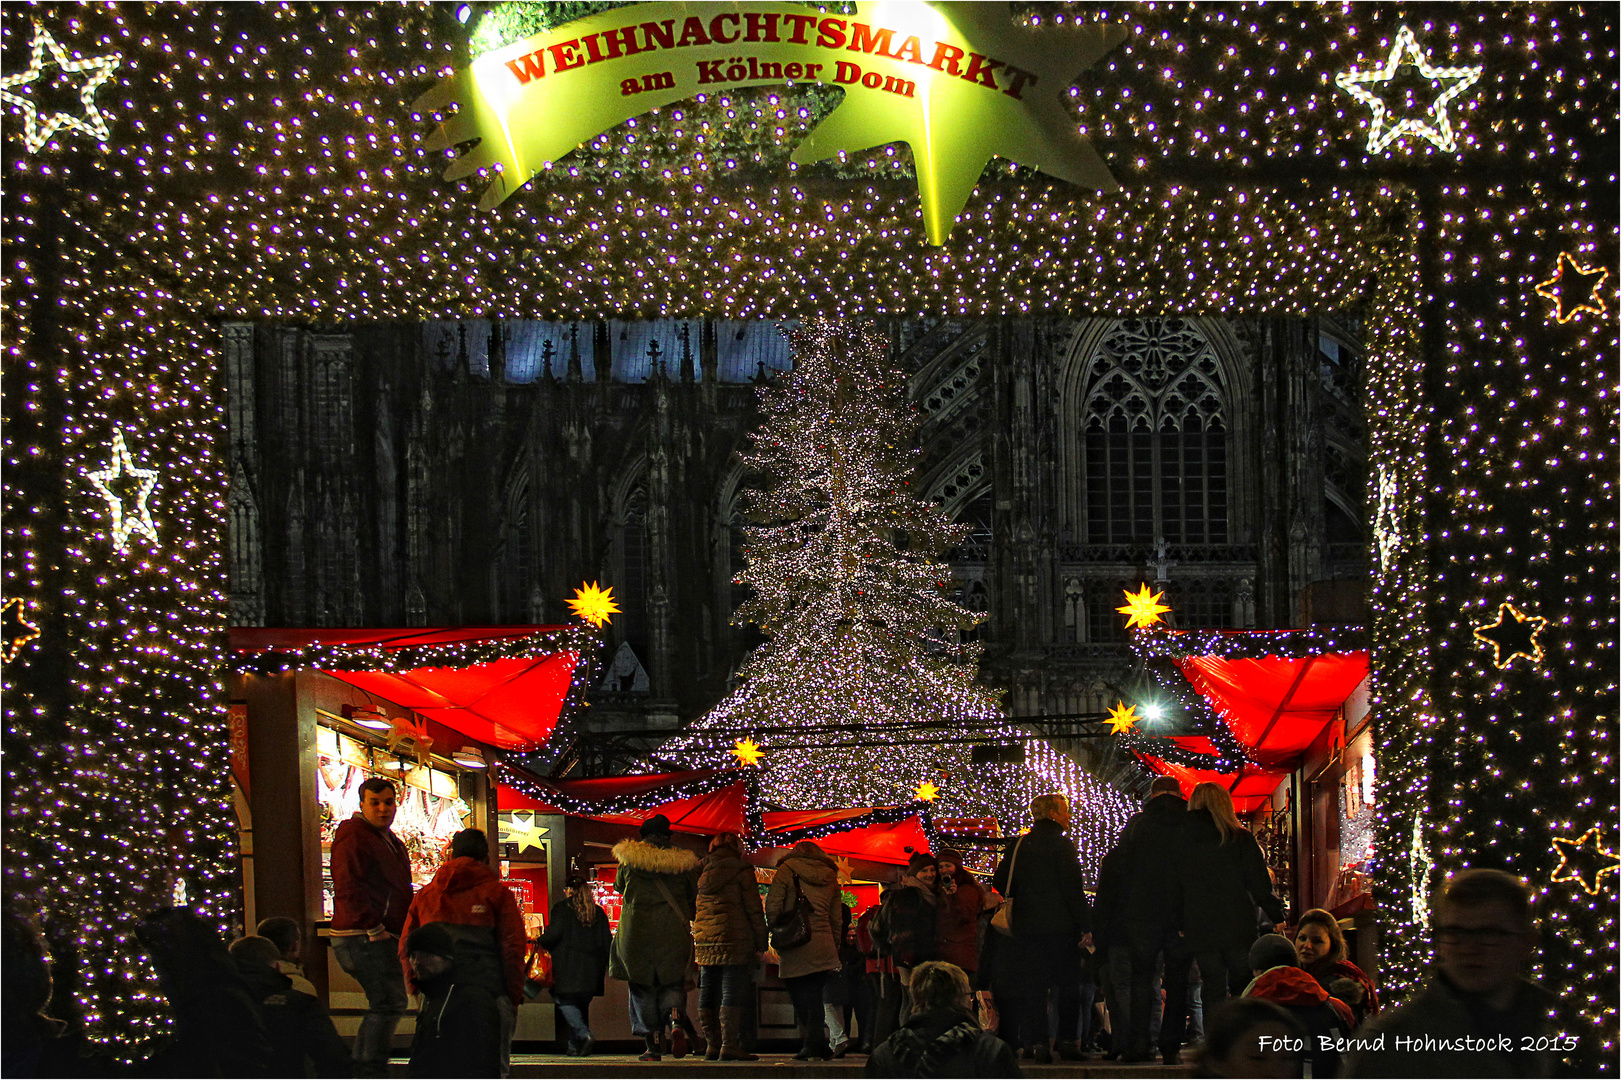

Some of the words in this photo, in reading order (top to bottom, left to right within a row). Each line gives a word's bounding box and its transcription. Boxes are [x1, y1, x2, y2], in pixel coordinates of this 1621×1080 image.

[505, 13, 1039, 101] WEIHNACHTSMARKT
[620, 71, 676, 96] am
[696, 56, 823, 84] Kölner
[833, 60, 915, 98] Dom
